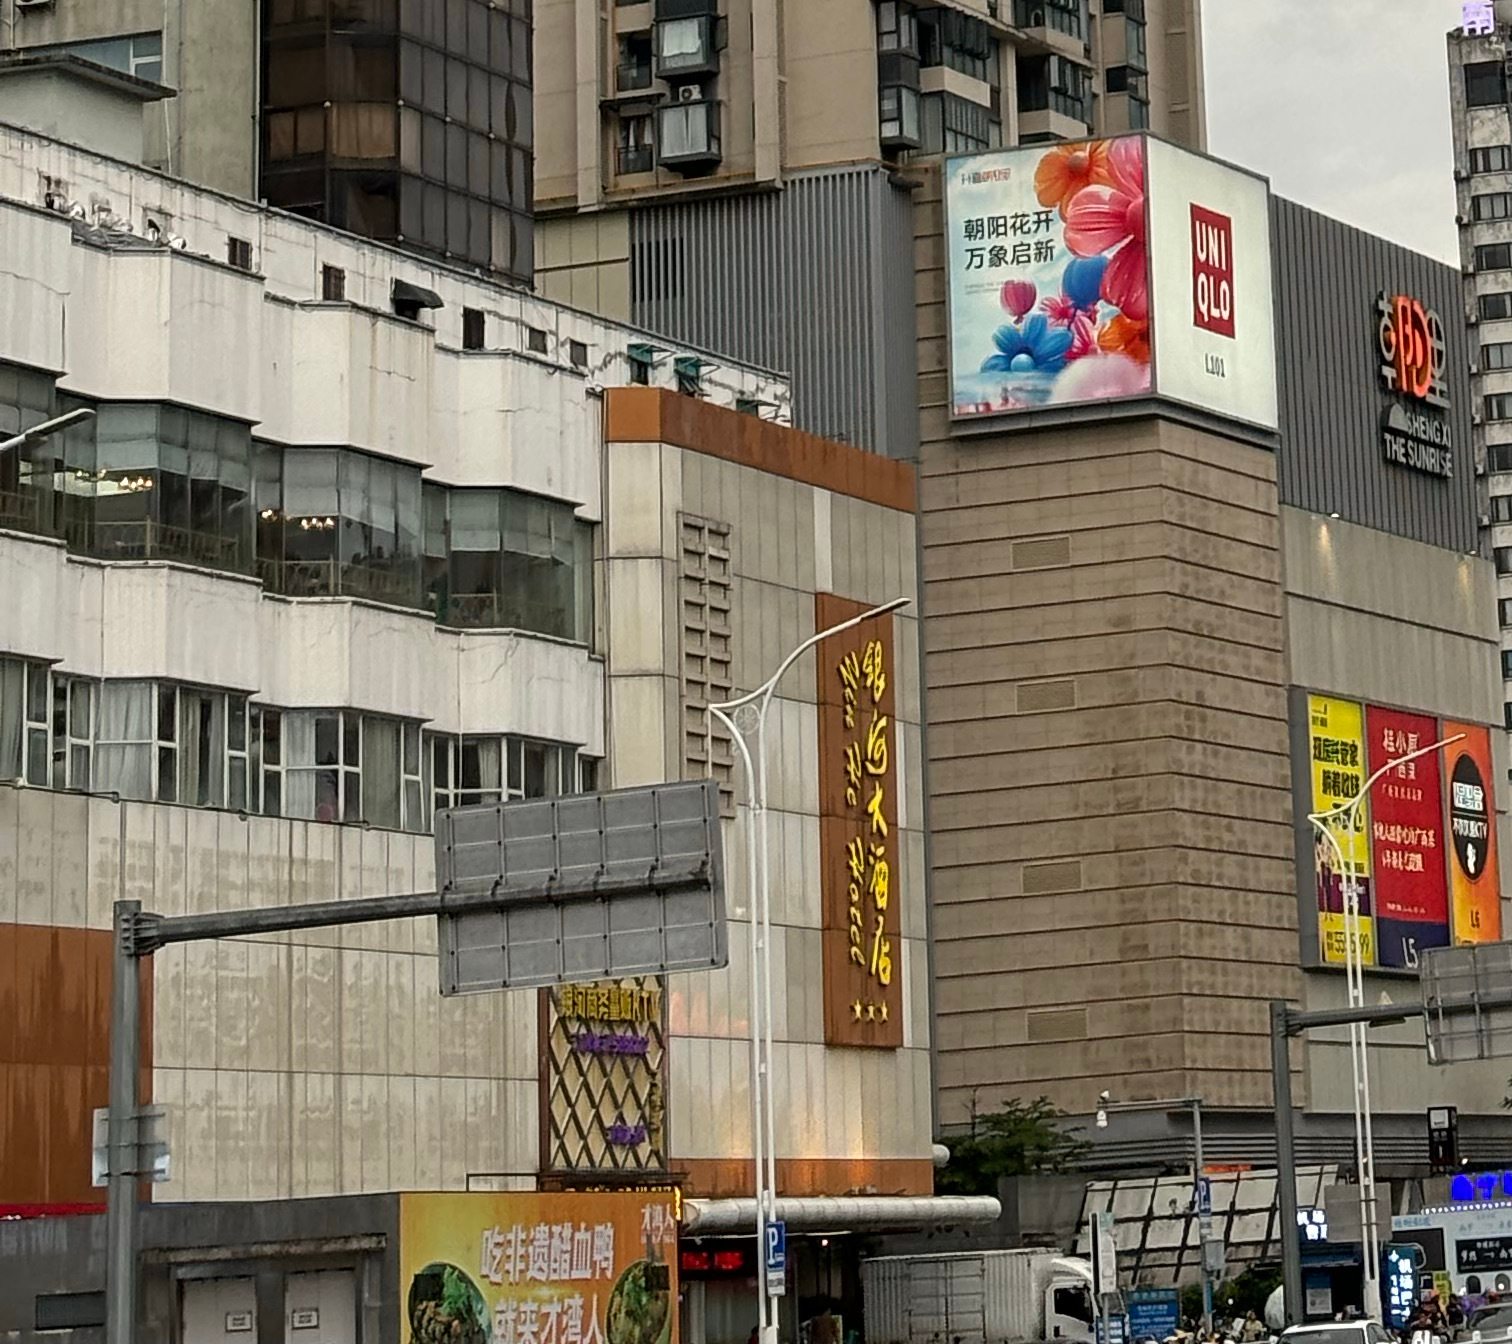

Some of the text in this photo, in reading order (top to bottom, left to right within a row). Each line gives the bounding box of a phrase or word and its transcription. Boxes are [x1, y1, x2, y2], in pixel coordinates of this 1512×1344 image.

[963, 210, 1054, 242] 朝阳花开
[1196, 219, 1227, 271] UNI
[964, 239, 1055, 271] 万象启新
[1198, 272, 1231, 324] QLO
[1384, 432, 1453, 478] THE SUNRISE
[862, 640, 892, 986] 银河大酒店
[480, 1222, 615, 1284] 吃非遗醋血鸭
